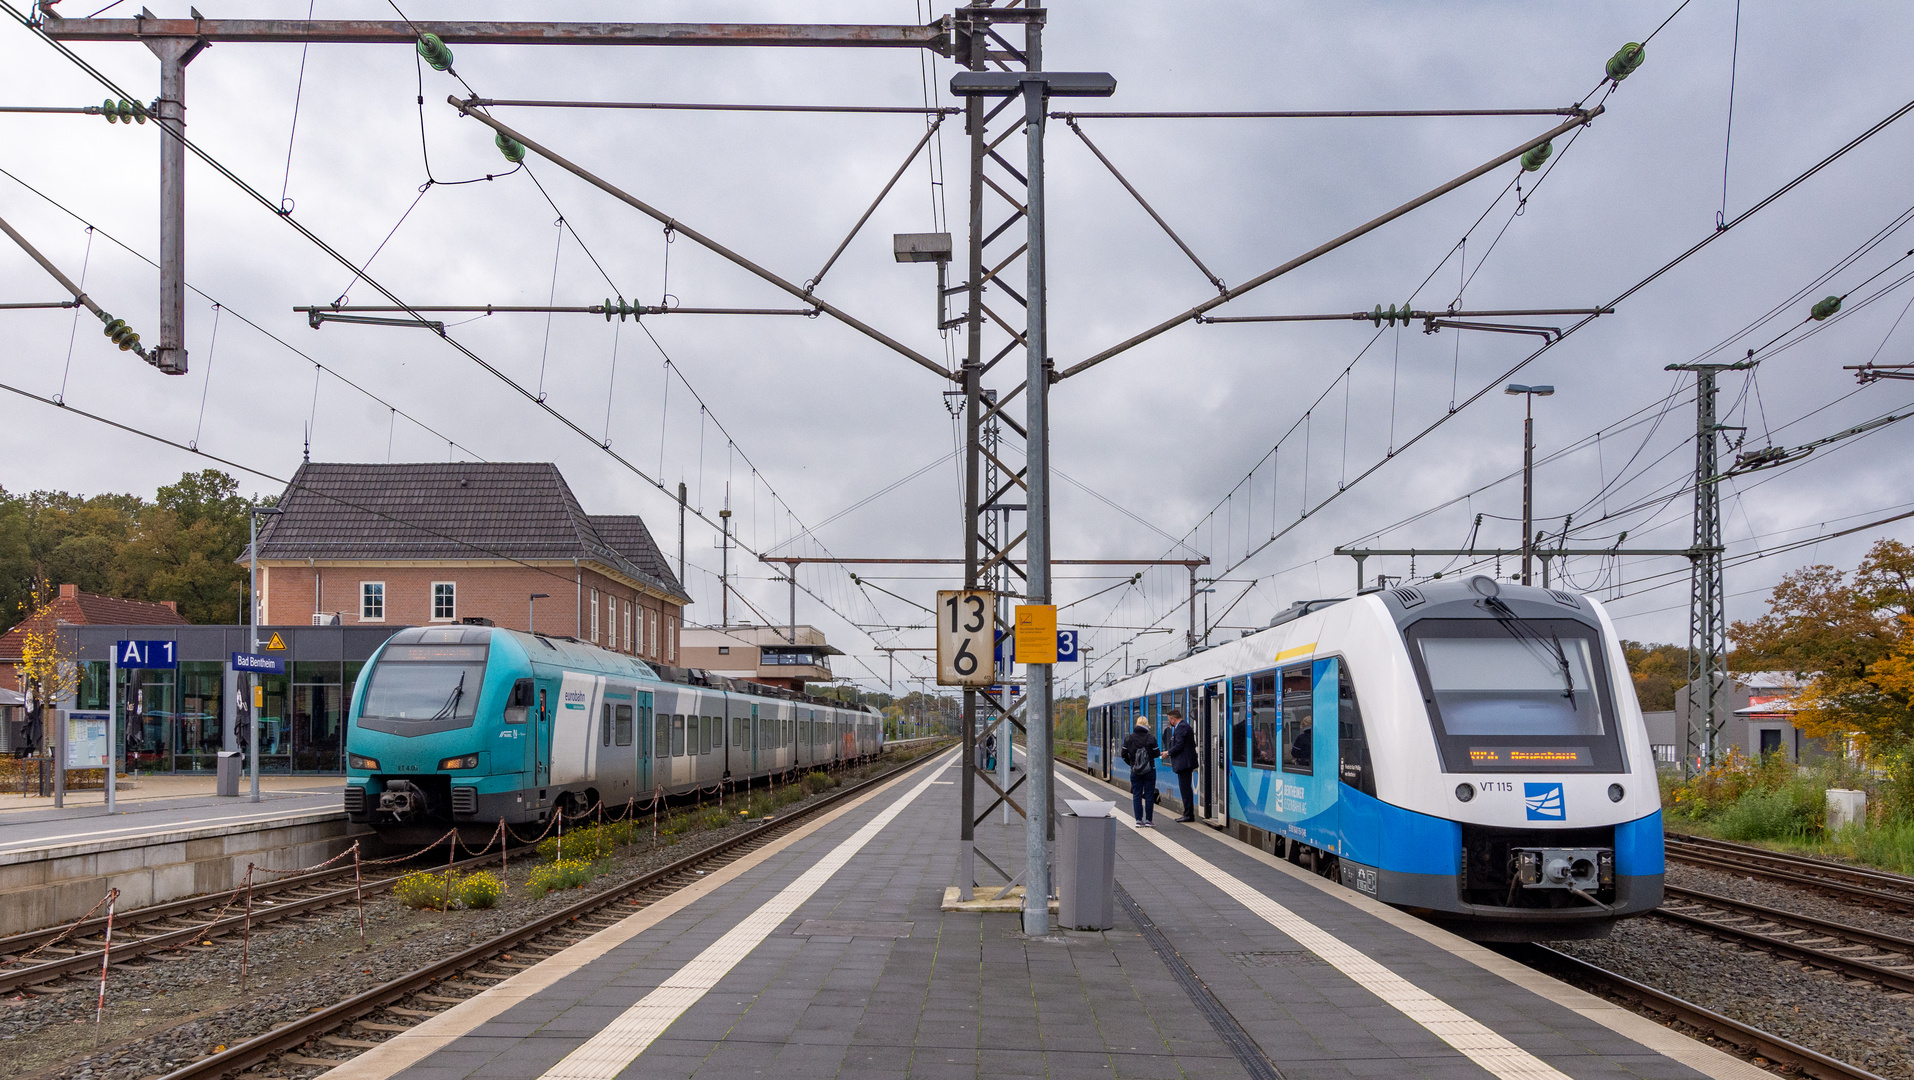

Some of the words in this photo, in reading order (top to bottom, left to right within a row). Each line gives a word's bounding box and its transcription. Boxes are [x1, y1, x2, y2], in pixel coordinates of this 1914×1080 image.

[946, 595, 985, 633] 13
[123, 641, 141, 663] A
[163, 641, 173, 663] 1
[1058, 631, 1074, 655] 3
[237, 655, 249, 666] Bad
[250, 656, 276, 669] Bentheim
[953, 638, 978, 676] 6
[565, 690, 585, 702] eurobahn
[1480, 781, 1494, 791] VT
[1497, 781, 1513, 792] 115
